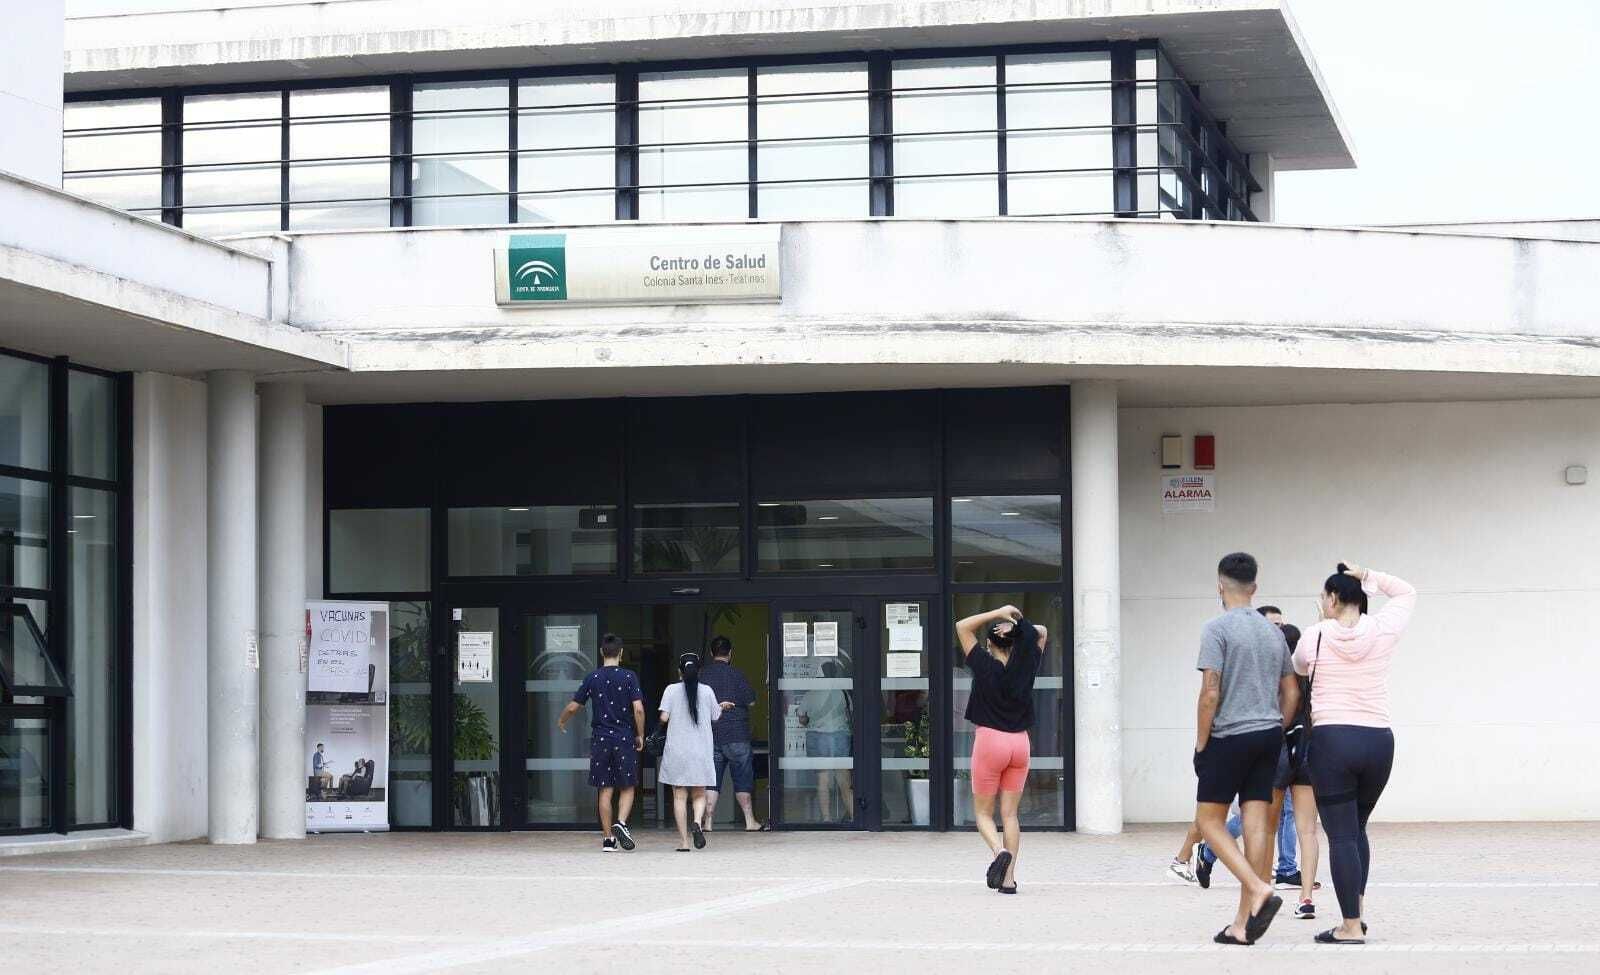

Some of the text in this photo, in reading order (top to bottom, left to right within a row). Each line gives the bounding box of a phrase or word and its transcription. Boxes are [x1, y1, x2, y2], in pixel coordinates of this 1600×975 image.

[650, 253, 766, 271] Centro de Salud
[643, 276, 676, 287] Colonia
[678, 274, 703, 286] Santa
[1164, 489, 1212, 498] ALARMA
[320, 609, 366, 622] VACUNAS
[320, 629, 368, 643] COVID
